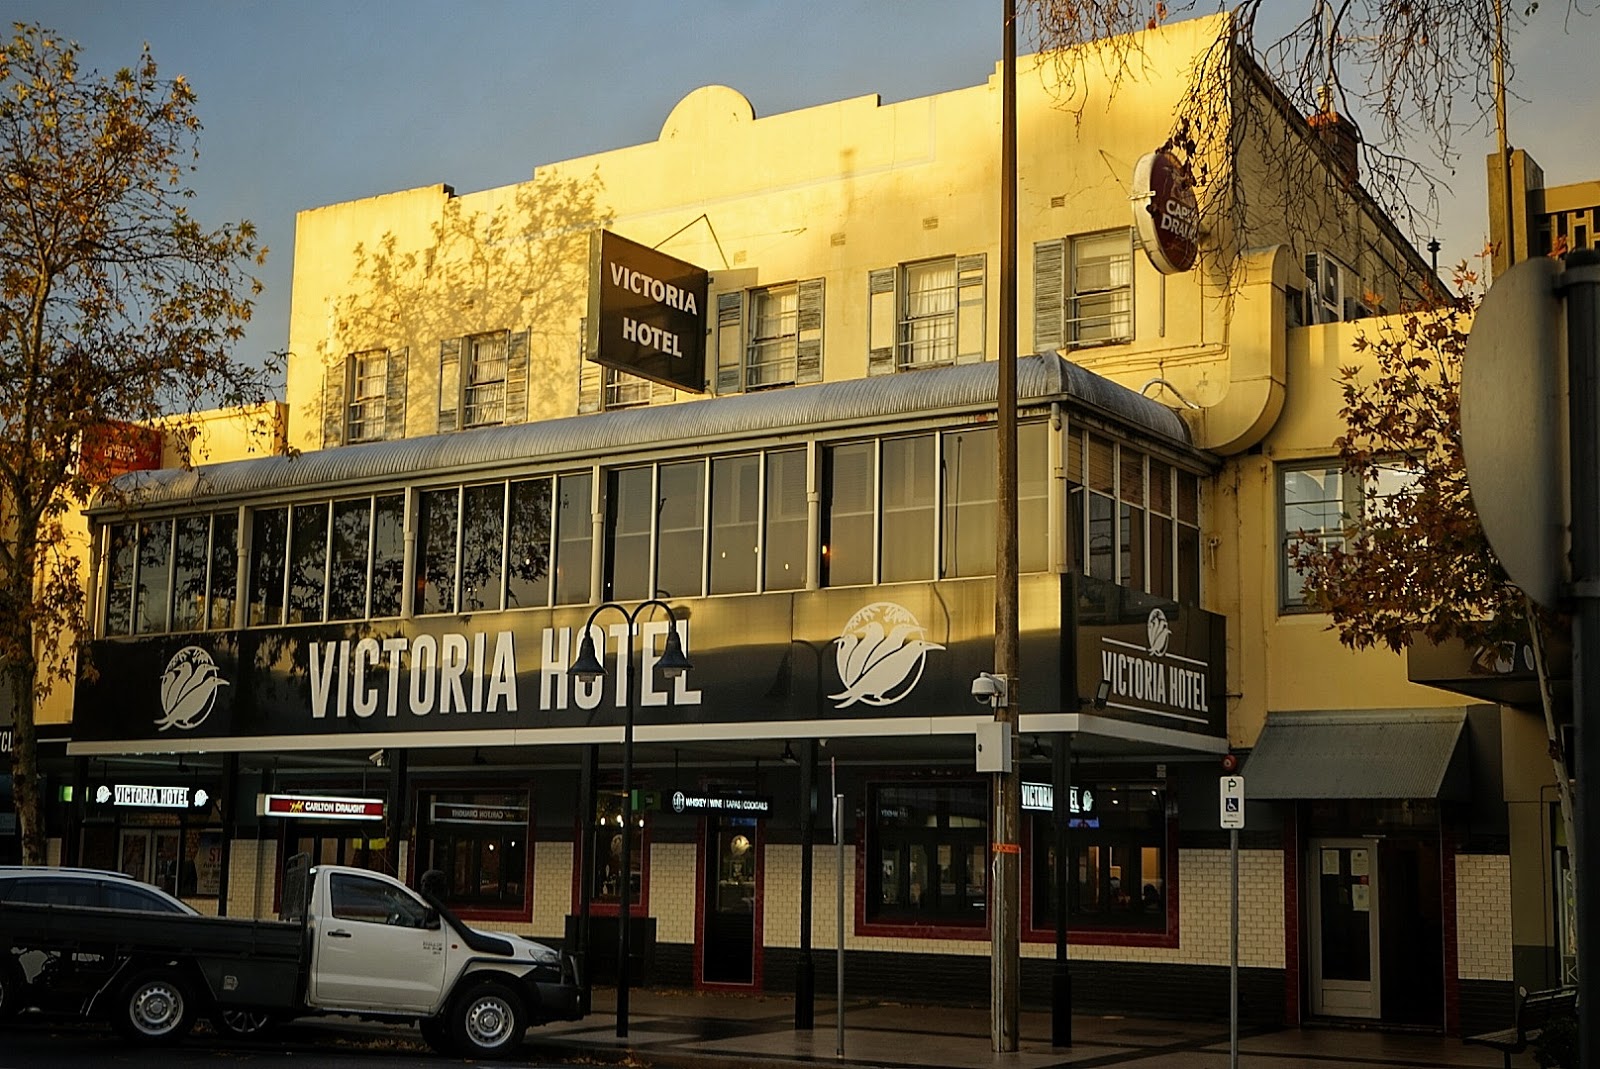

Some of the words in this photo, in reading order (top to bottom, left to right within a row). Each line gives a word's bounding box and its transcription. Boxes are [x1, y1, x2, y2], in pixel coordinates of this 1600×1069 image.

[610, 261, 698, 316] VICTORIA
[622, 317, 683, 359] HOTEL
[308, 630, 518, 719] VICTORIA
[539, 618, 703, 712] HOTEL
[1101, 650, 1167, 705] VICTORIA
[1169, 665, 1209, 713] HOTEL
[114, 786, 159, 805] VICTORIA
[160, 788, 188, 806] HOTEL
[1228, 779, 1237, 793] P
[304, 801, 335, 813] CARLTON
[335, 802, 366, 815] DRAUGHT
[709, 798, 723, 809] WINE
[726, 799, 741, 810] TAPAS
